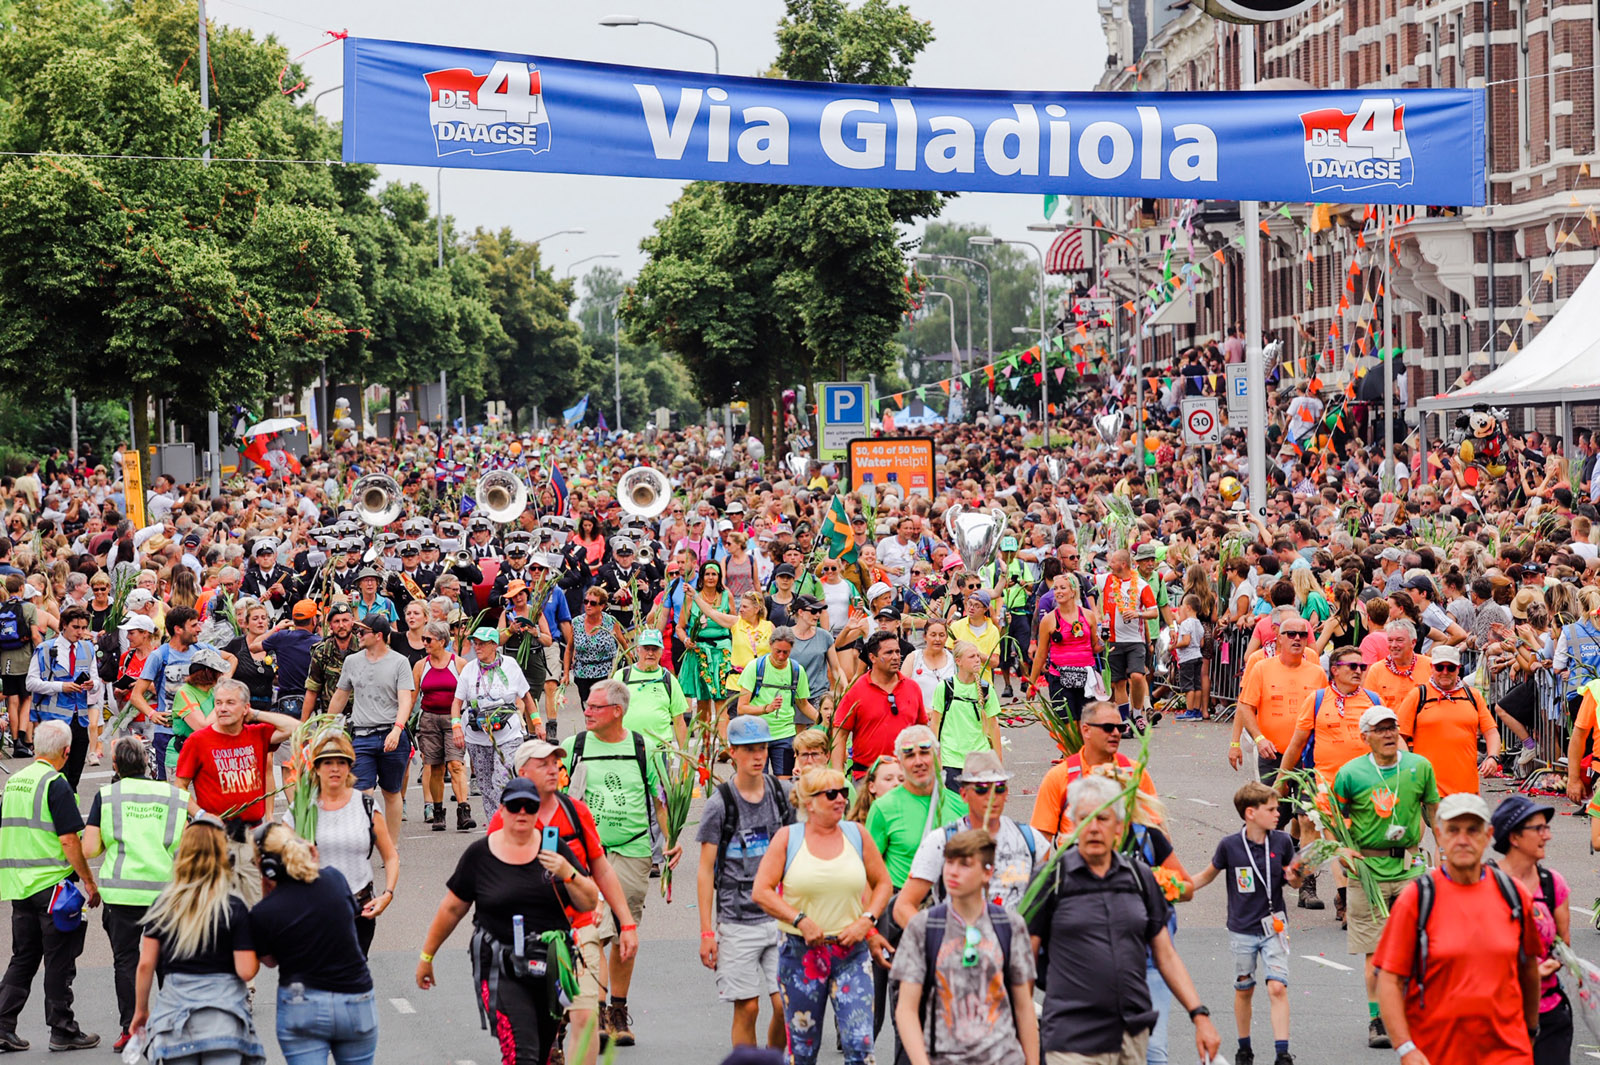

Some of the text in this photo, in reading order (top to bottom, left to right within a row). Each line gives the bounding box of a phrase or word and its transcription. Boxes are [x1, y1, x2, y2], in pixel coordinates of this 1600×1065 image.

[438, 60, 538, 124] DE 4
[437, 121, 538, 146] DAAGSE
[631, 82, 1220, 183] Via Gladiola
[1311, 98, 1403, 161] DE 4
[1310, 160, 1402, 181] DAAGSE
[834, 389, 856, 421] P
[1193, 417, 1209, 427] 30
[856, 446, 928, 456] 30, 40 of 50 km
[856, 456, 928, 468] Water helpt!
